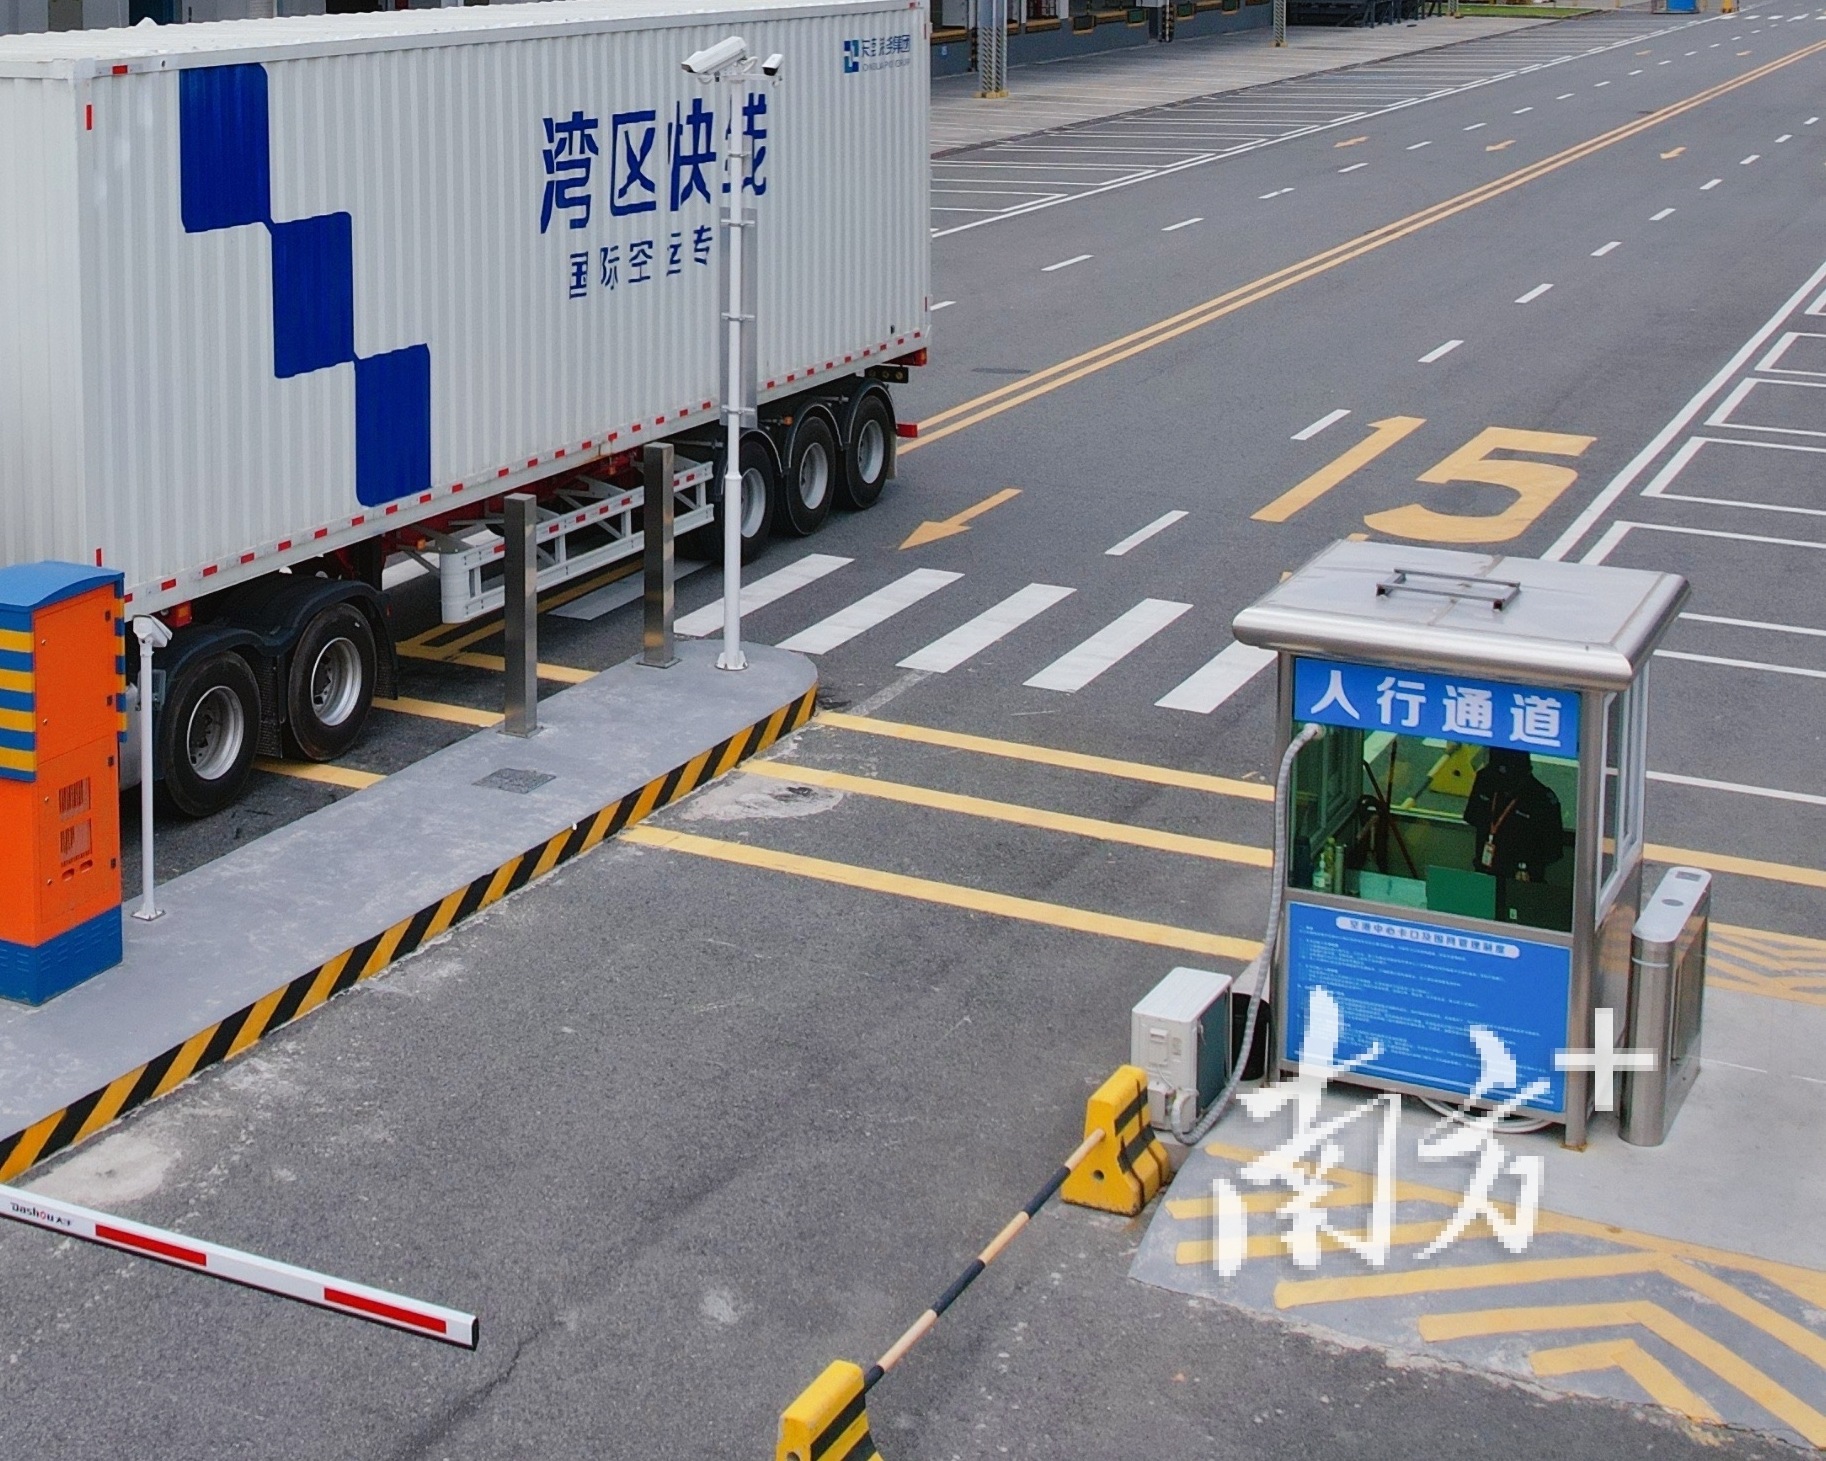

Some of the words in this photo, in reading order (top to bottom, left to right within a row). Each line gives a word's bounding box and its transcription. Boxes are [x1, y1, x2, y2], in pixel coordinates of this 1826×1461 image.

[540, 92, 767, 234] 湾区快线
[569, 224, 714, 300] 国际空运专
[1249, 415, 1598, 543] 15
[1310, 669, 1562, 748] 人行通道
